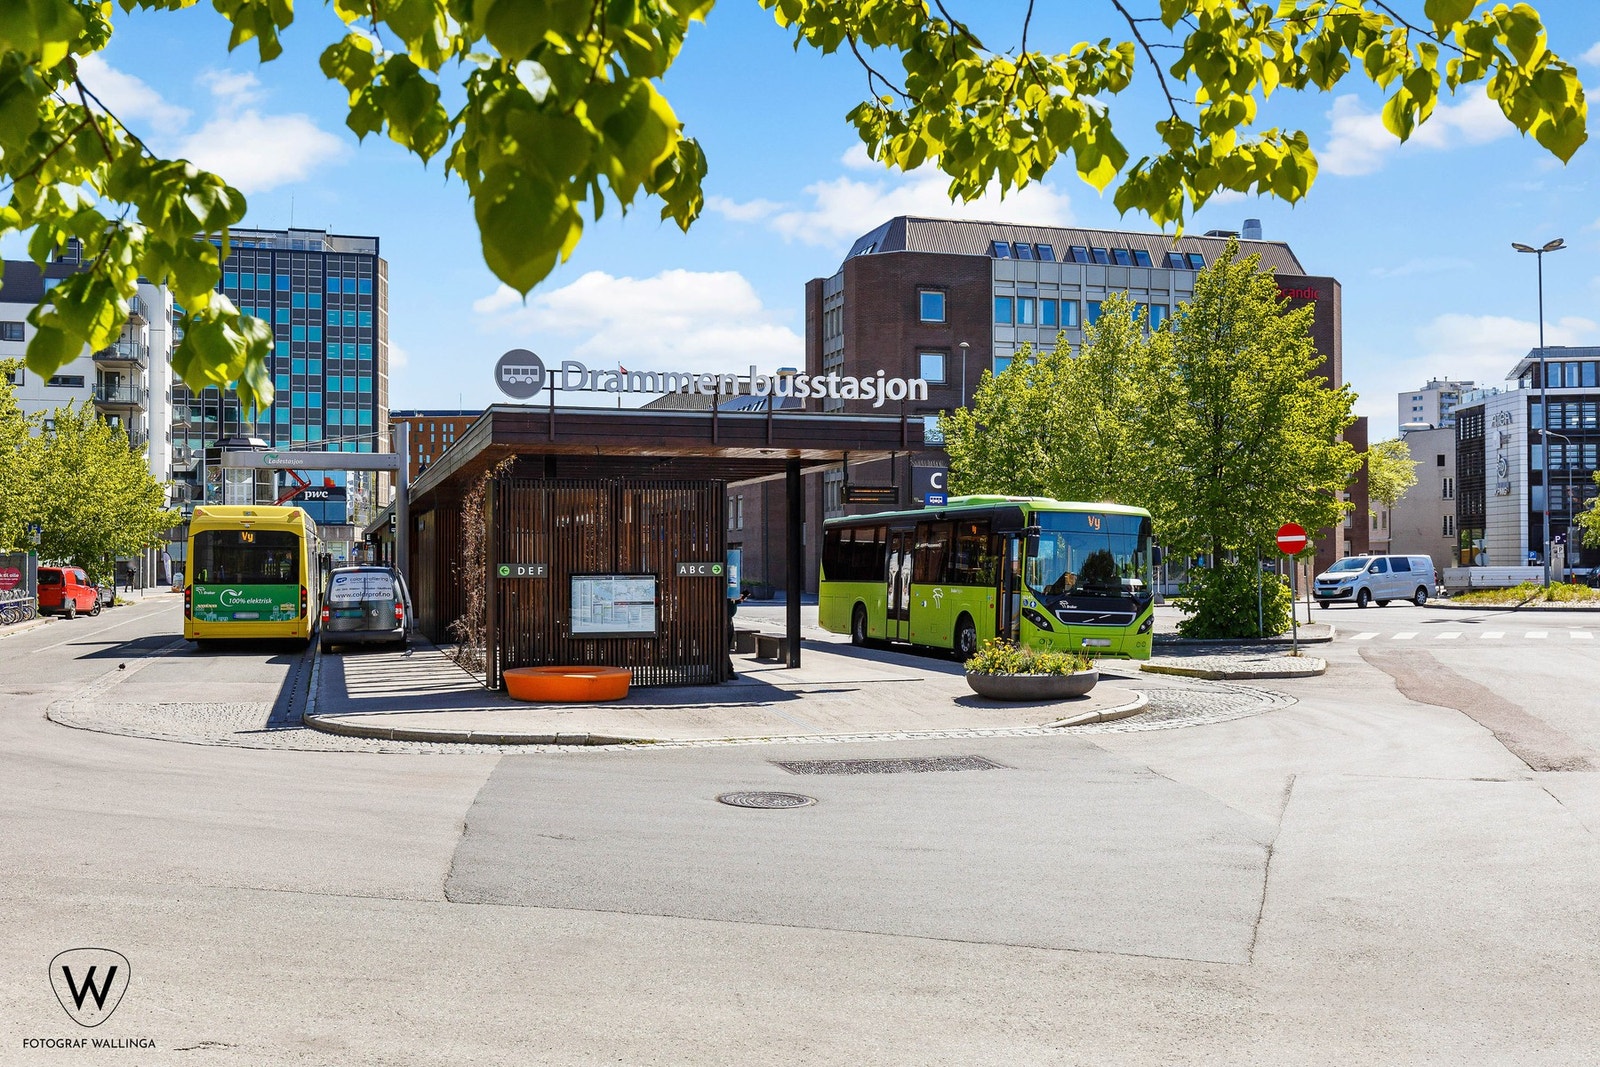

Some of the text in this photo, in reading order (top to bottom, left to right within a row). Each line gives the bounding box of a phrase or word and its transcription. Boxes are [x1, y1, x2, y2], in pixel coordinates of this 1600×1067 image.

[561, 360, 928, 408] Drammen busstasjon
[930, 472, 942, 489] C
[304, 491, 328, 500] pwc
[1087, 515, 1101, 530] Vy
[241, 531, 254, 543] Vy
